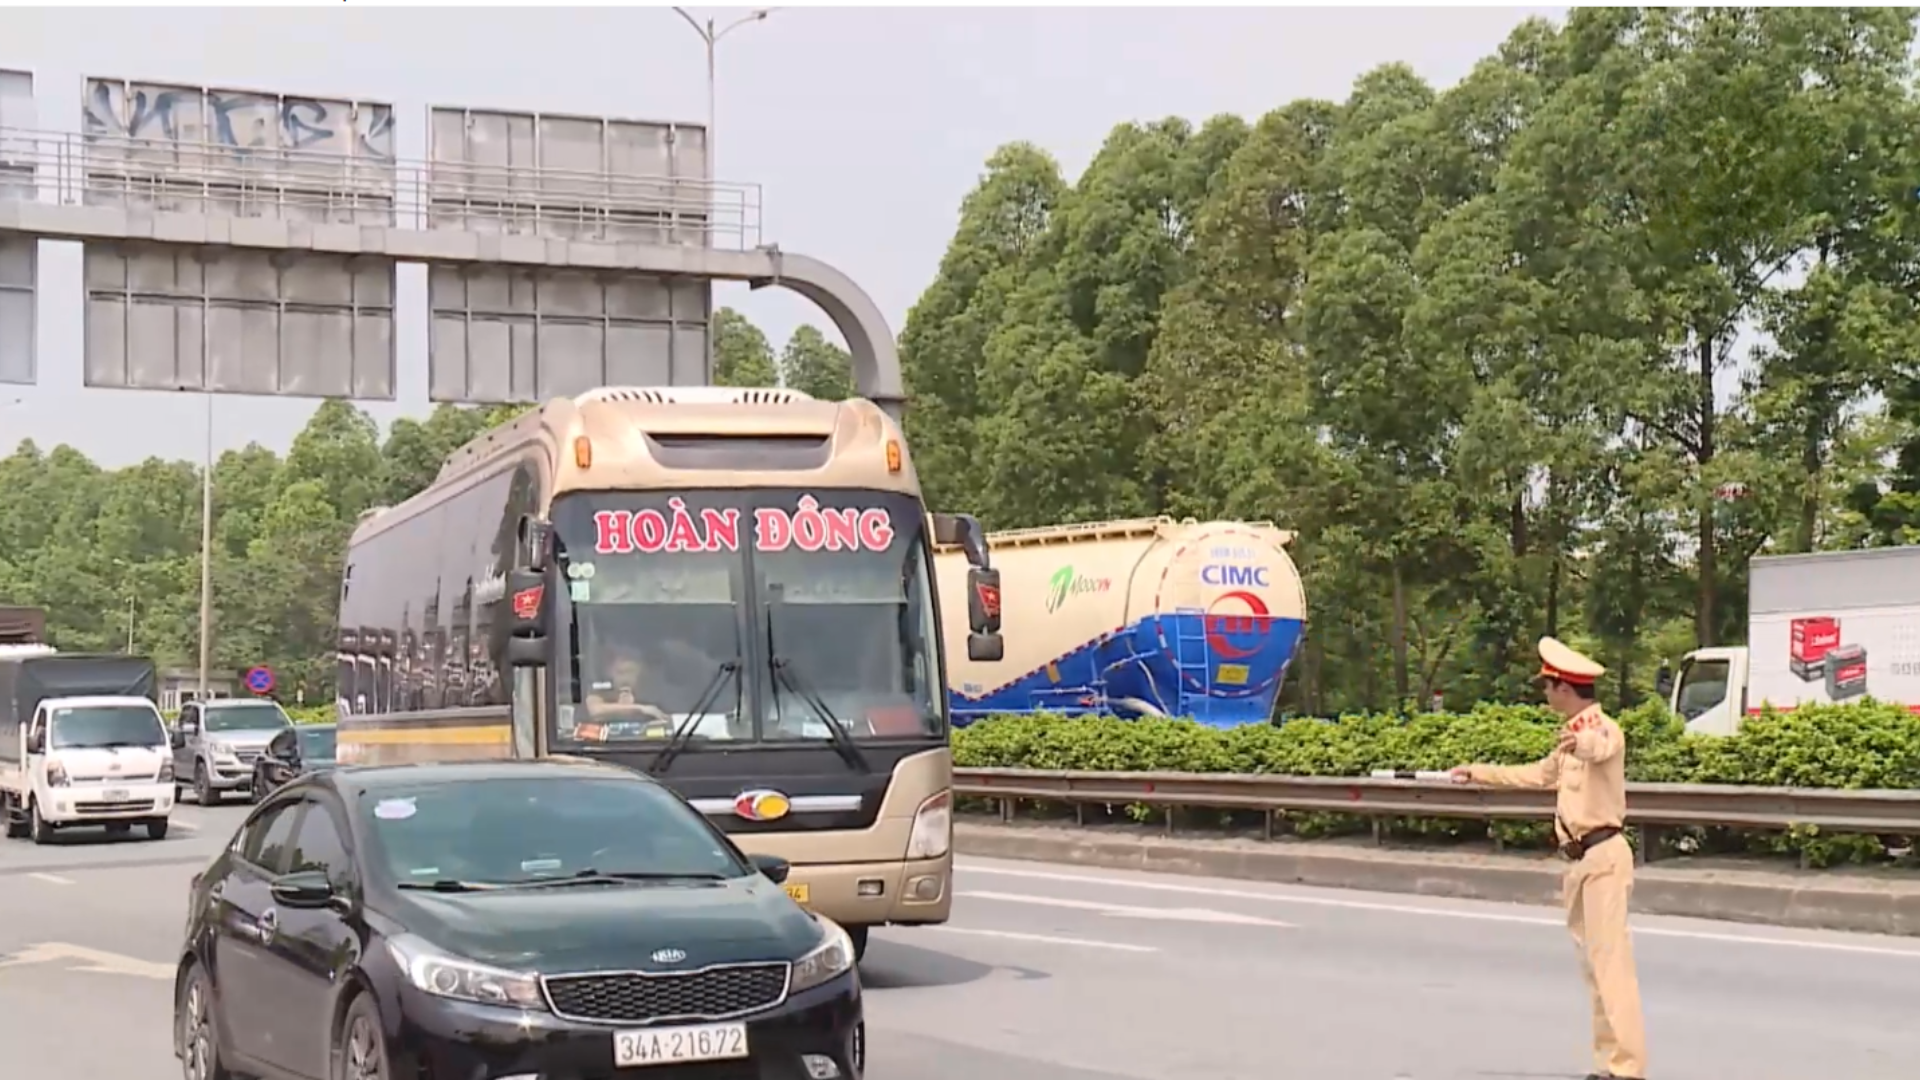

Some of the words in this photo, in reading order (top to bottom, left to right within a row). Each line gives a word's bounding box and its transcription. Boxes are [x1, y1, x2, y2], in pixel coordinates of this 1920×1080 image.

[594, 497, 740, 552] HOÀN
[755, 495, 893, 552] ĐÔNG
[1201, 564, 1270, 588] CIMC
